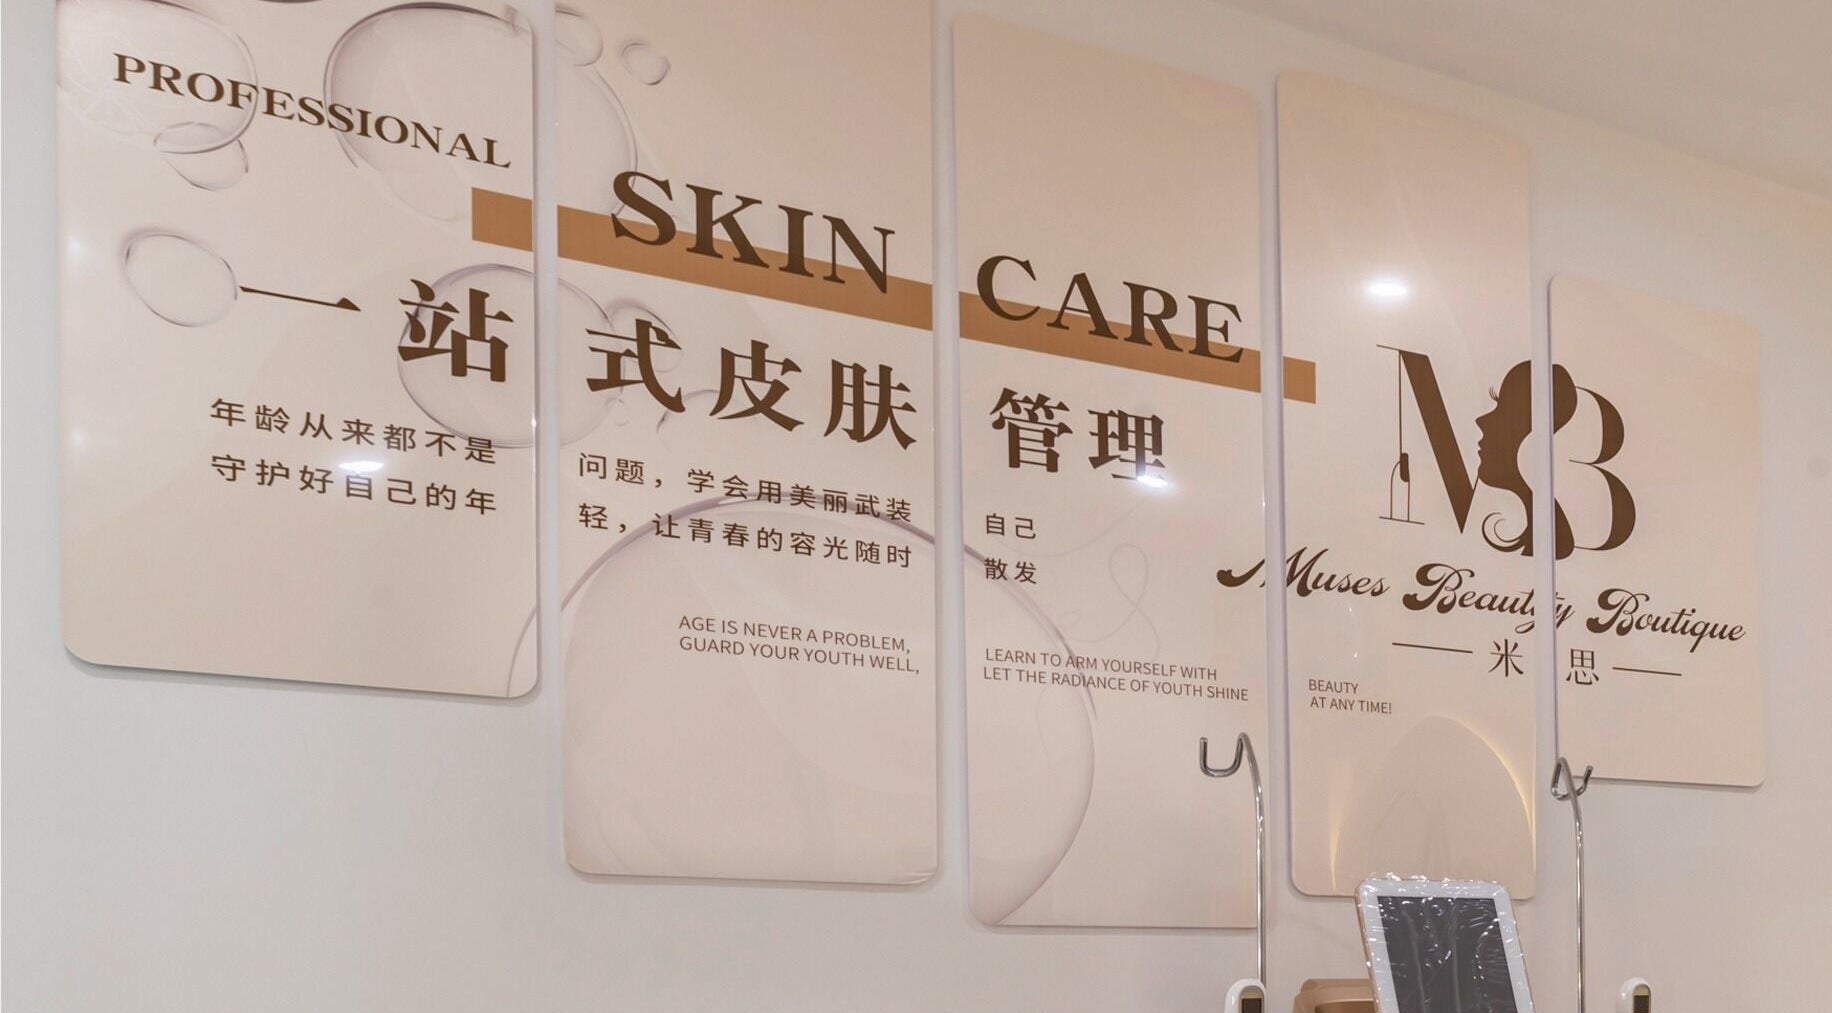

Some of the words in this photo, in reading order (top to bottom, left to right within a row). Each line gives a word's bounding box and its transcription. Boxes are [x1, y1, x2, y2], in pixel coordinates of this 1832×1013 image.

[113, 53, 512, 168] PROFESSIONAL
[611, 171, 895, 294] SKIN
[976, 255, 1244, 364] CARE
[239, 279, 514, 383] 一站
[585, 318, 918, 450] 式皮肤
[989, 387, 1168, 483] 管理
[210, 398, 497, 464] 年龄从来都不是
[985, 513, 1037, 540] 自己
[210, 454, 497, 515] 守护好自己的年
[984, 557, 1038, 584] 散发
[1216, 546, 1390, 598] Muses
[1402, 563, 1576, 635] Beauty
[1586, 587, 1747, 653] Boutique
[679, 615, 716, 632] AGE
[722, 620, 738, 635] IS
[743, 621, 803, 641] NEVER
[806, 629, 818, 643] A
[822, 630, 911, 655] PROBLEM,
[679, 635, 745, 656] GUARD
[749, 642, 800, 662] YOUR
[803, 648, 865, 667] YOUTH
[869, 654, 920, 675] WELL,
[985, 648, 1036, 665] LEARN
[1040, 652, 1061, 667] TO
[1065, 655, 1098, 671] ARM
[1101, 658, 1177, 678] YOURSELF
[1180, 665, 1217, 681] WITH
[1488, 638, 1524, 678] 米
[1565, 648, 1600, 686] 思
[983, 666, 1011, 681] LET
[1016, 669, 1047, 684] THE
[1051, 672, 1126, 691] RADIANCE
[1130, 679, 1150, 692] OF
[1153, 681, 1203, 698] YOUTH
[1206, 685, 1249, 701] SHINE
[1308, 678, 1358, 694] BEAUTY
[1310, 696, 1326, 709] AT
[1330, 698, 1355, 711] ANY
[1358, 700, 1392, 714] TIME!
